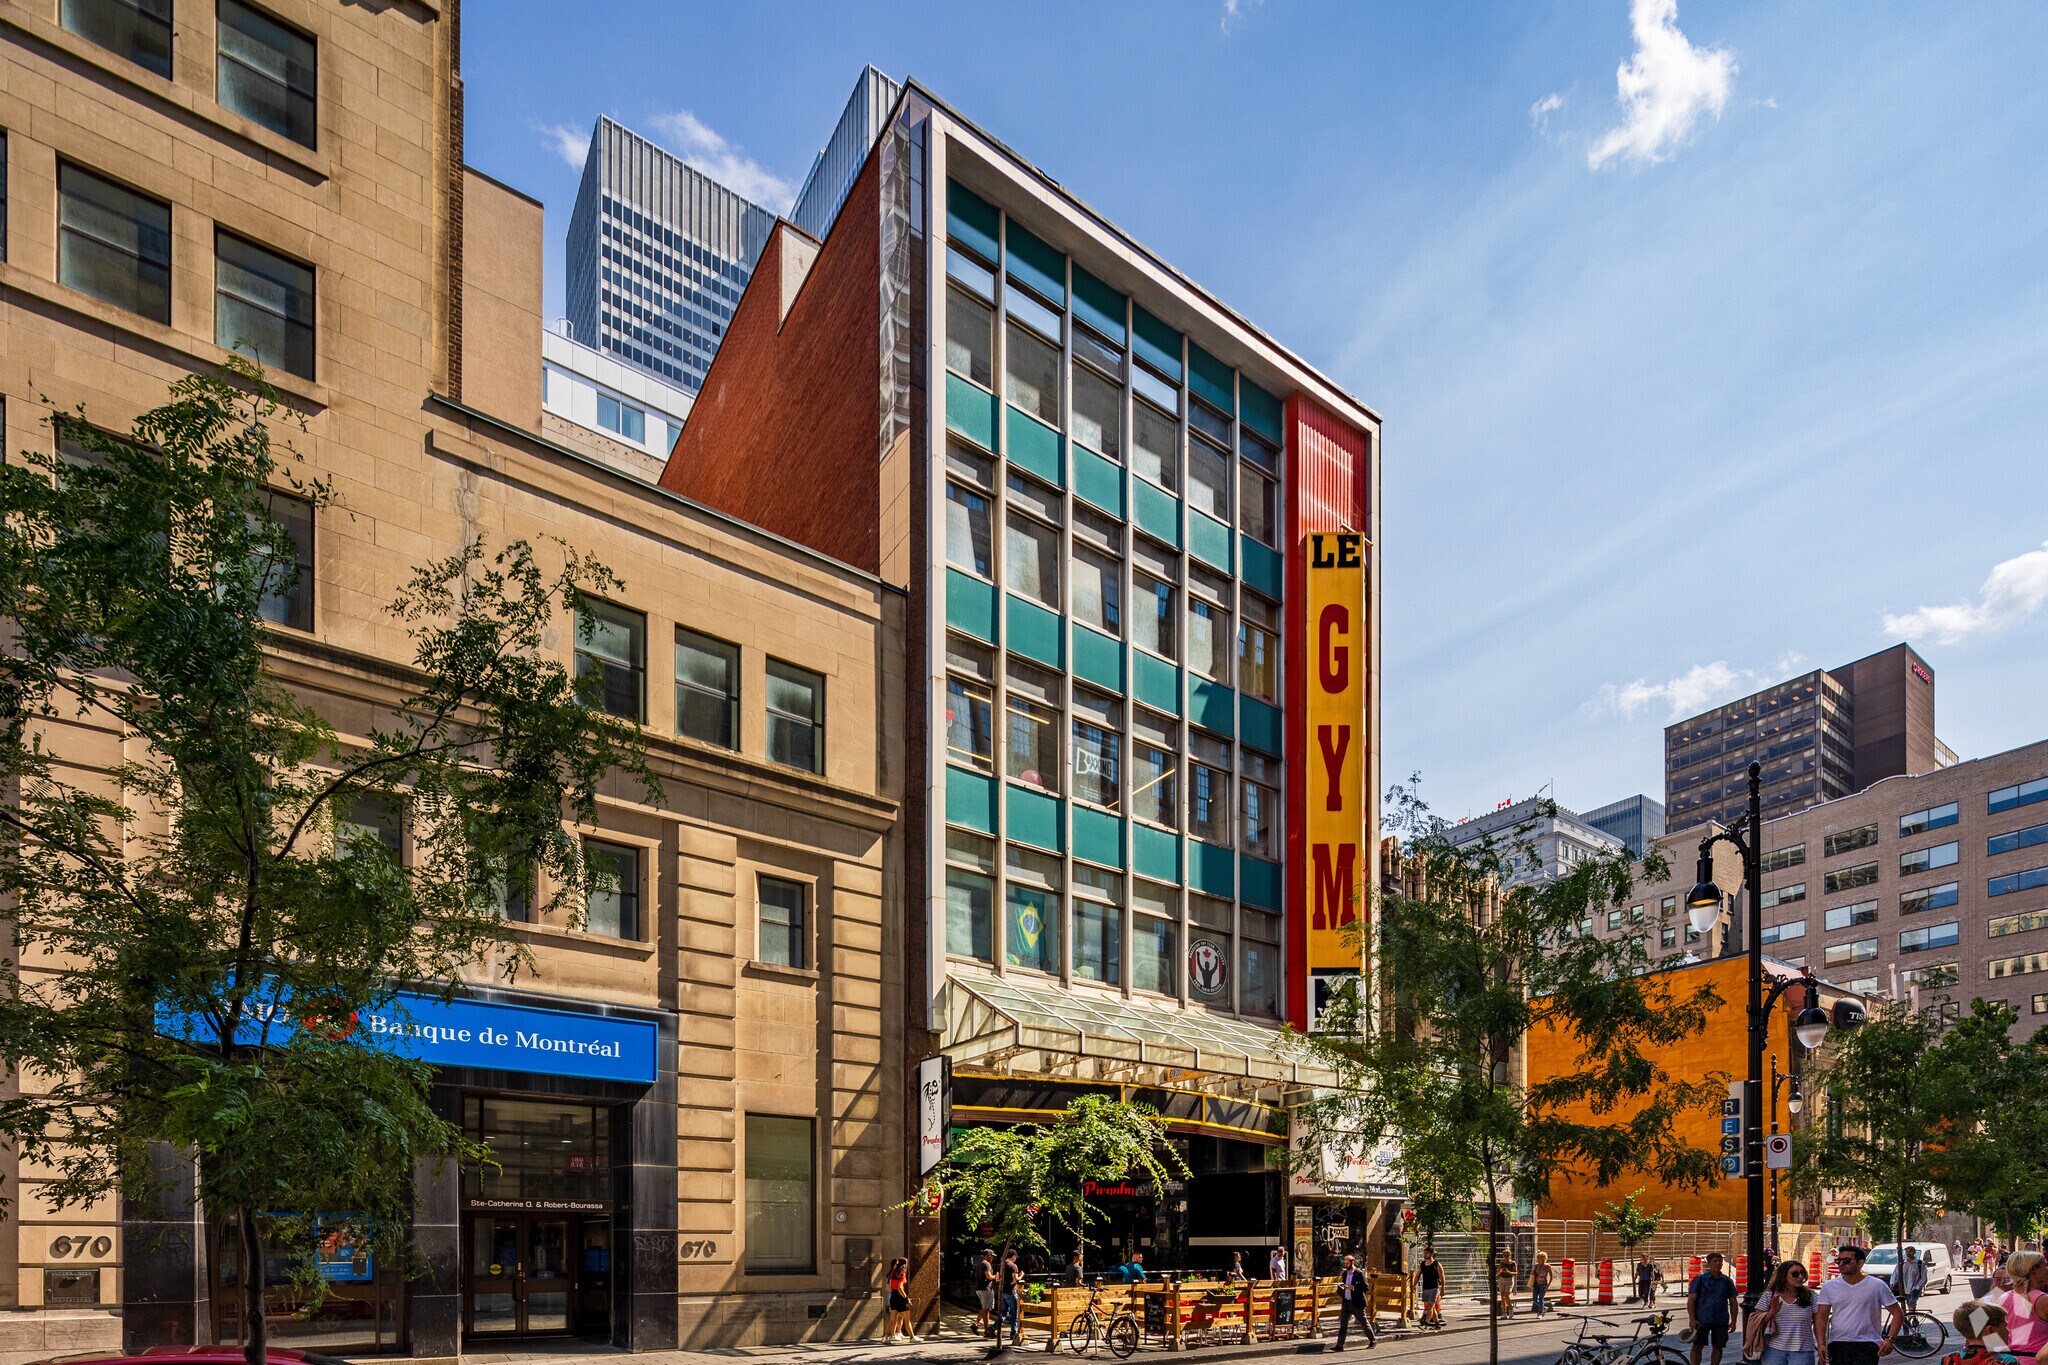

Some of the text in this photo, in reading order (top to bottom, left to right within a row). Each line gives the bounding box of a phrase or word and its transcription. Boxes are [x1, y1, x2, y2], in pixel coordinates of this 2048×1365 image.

[1311, 534, 1361, 569] LE
[1311, 603, 1356, 931] GYM
[369, 1014, 471, 1045] Banque
[478, 1027, 508, 1046] de
[515, 1031, 621, 1058] Montréal
[470, 1199, 603, 1210] Ste-Catherine O. & Robert-Bourassa
[49, 1235, 112, 1259] 670
[681, 1240, 717, 1258] 670
